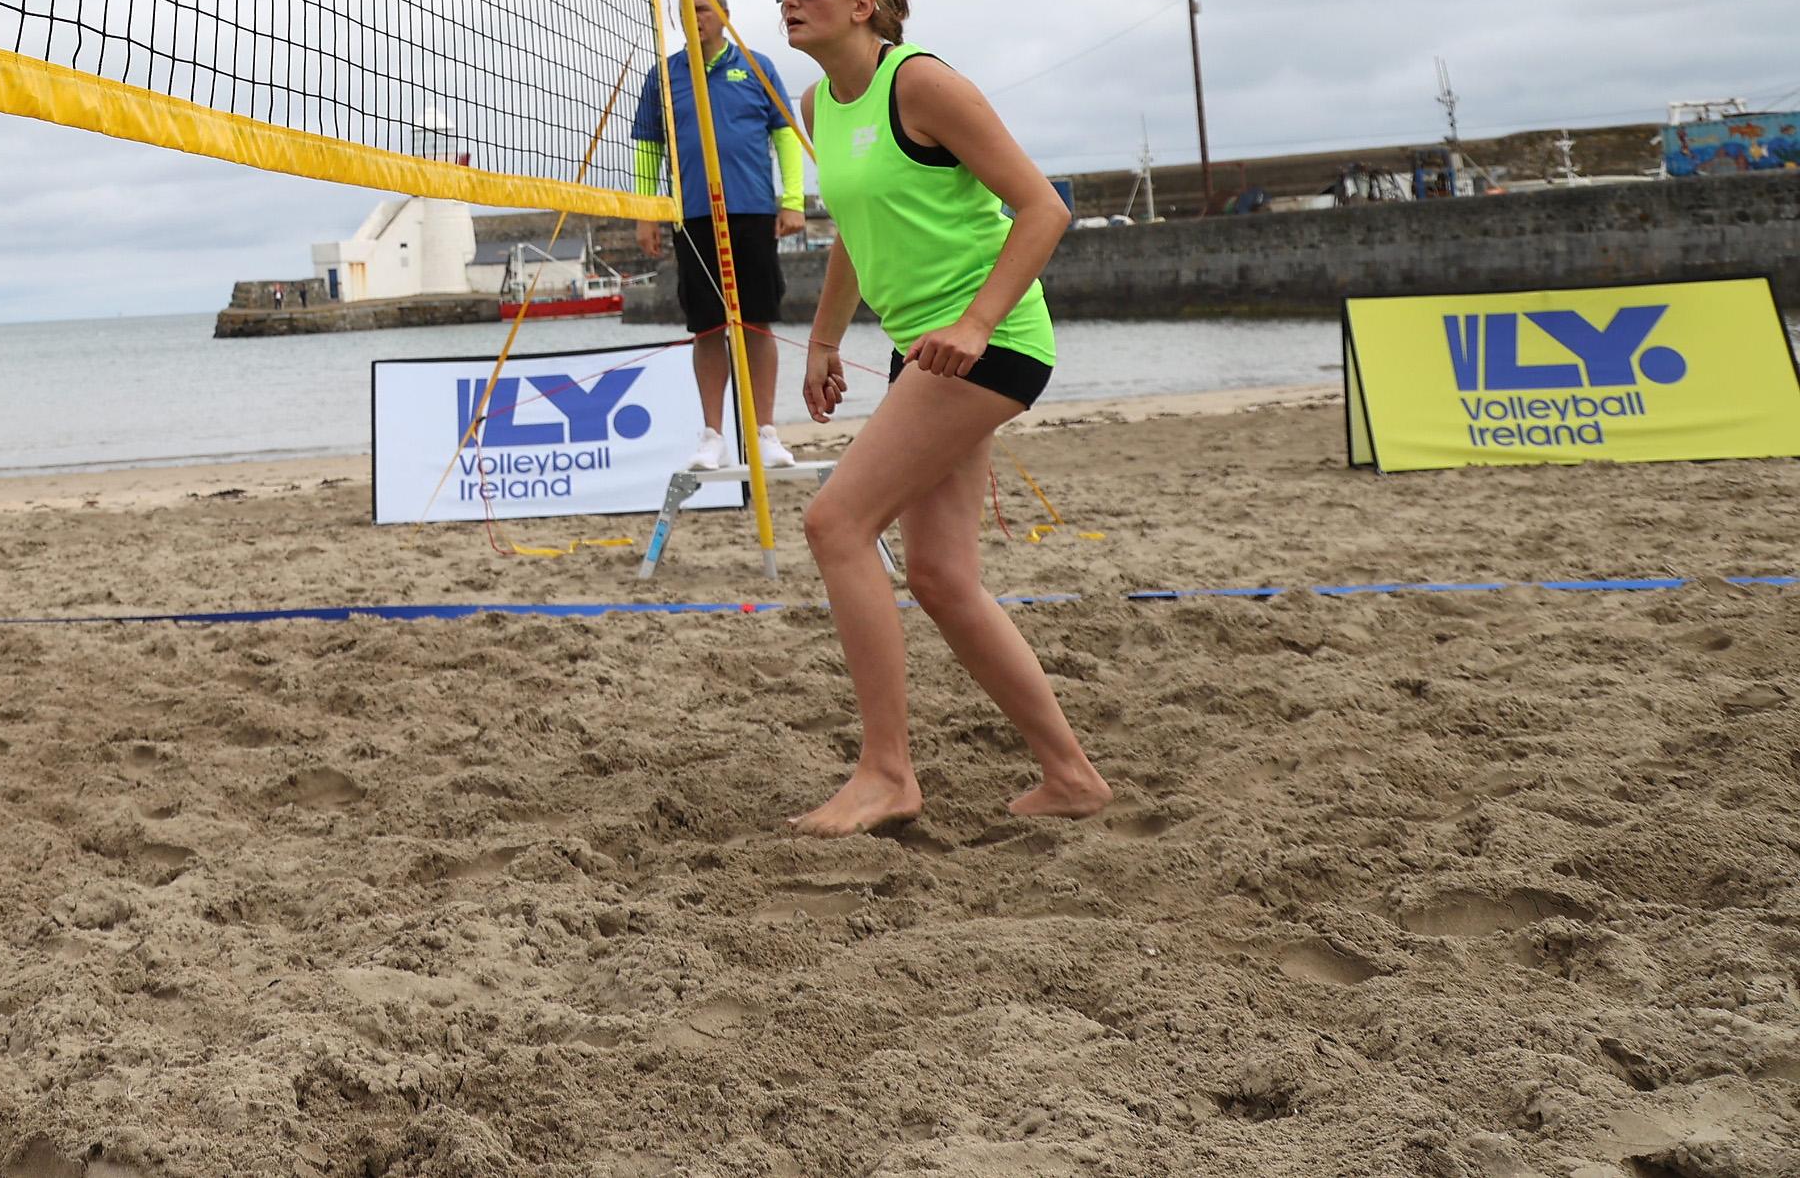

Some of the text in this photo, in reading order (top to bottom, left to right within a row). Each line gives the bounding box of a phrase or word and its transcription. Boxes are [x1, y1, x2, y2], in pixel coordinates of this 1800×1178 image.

[1461, 391, 1645, 421] Volleyball
[1468, 421, 1604, 446] Ireland
[459, 447, 610, 478] Volleyball
[461, 474, 571, 501] Ireland
